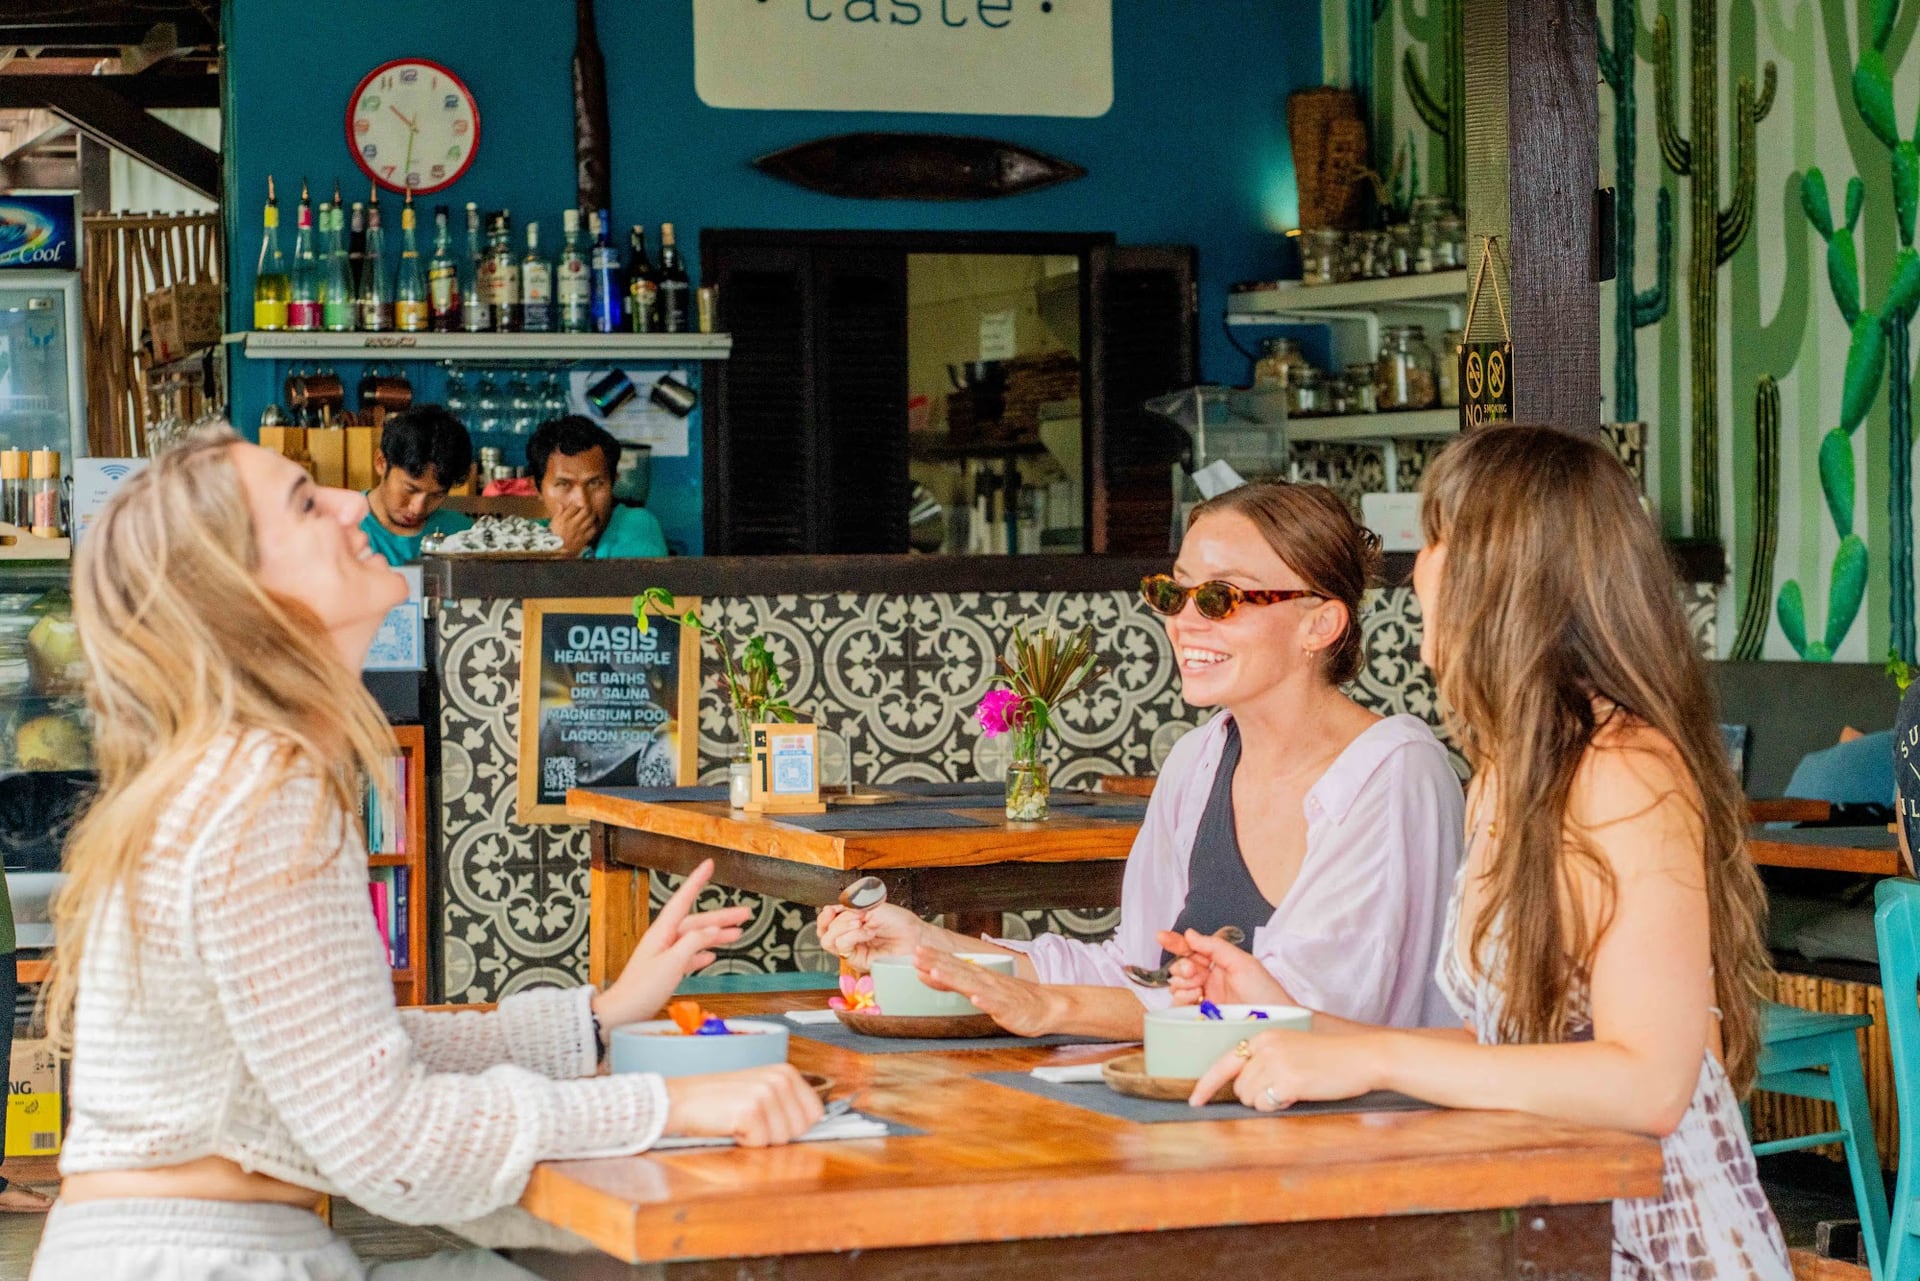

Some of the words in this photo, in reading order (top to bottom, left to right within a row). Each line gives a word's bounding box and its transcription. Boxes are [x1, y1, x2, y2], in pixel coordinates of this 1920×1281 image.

[445, 94, 459, 109] 2
[381, 165, 396, 179] 7
[431, 165, 445, 178] 5
[20, 240, 66, 264] Cool
[1465, 404, 1482, 427] NO
[567, 625, 659, 651] OASIS
[554, 650, 611, 664] HEALTH
[613, 651, 671, 665] TEMPLE
[575, 672, 597, 683] ICE
[600, 672, 646, 685] BATHS
[570, 687, 600, 699] DRY
[602, 687, 650, 700] SAUNA
[548, 708, 632, 721] MAGNESIUM
[634, 709, 671, 723] POOL
[561, 731, 617, 743] LAGOON
[621, 731, 657, 743] POOL
